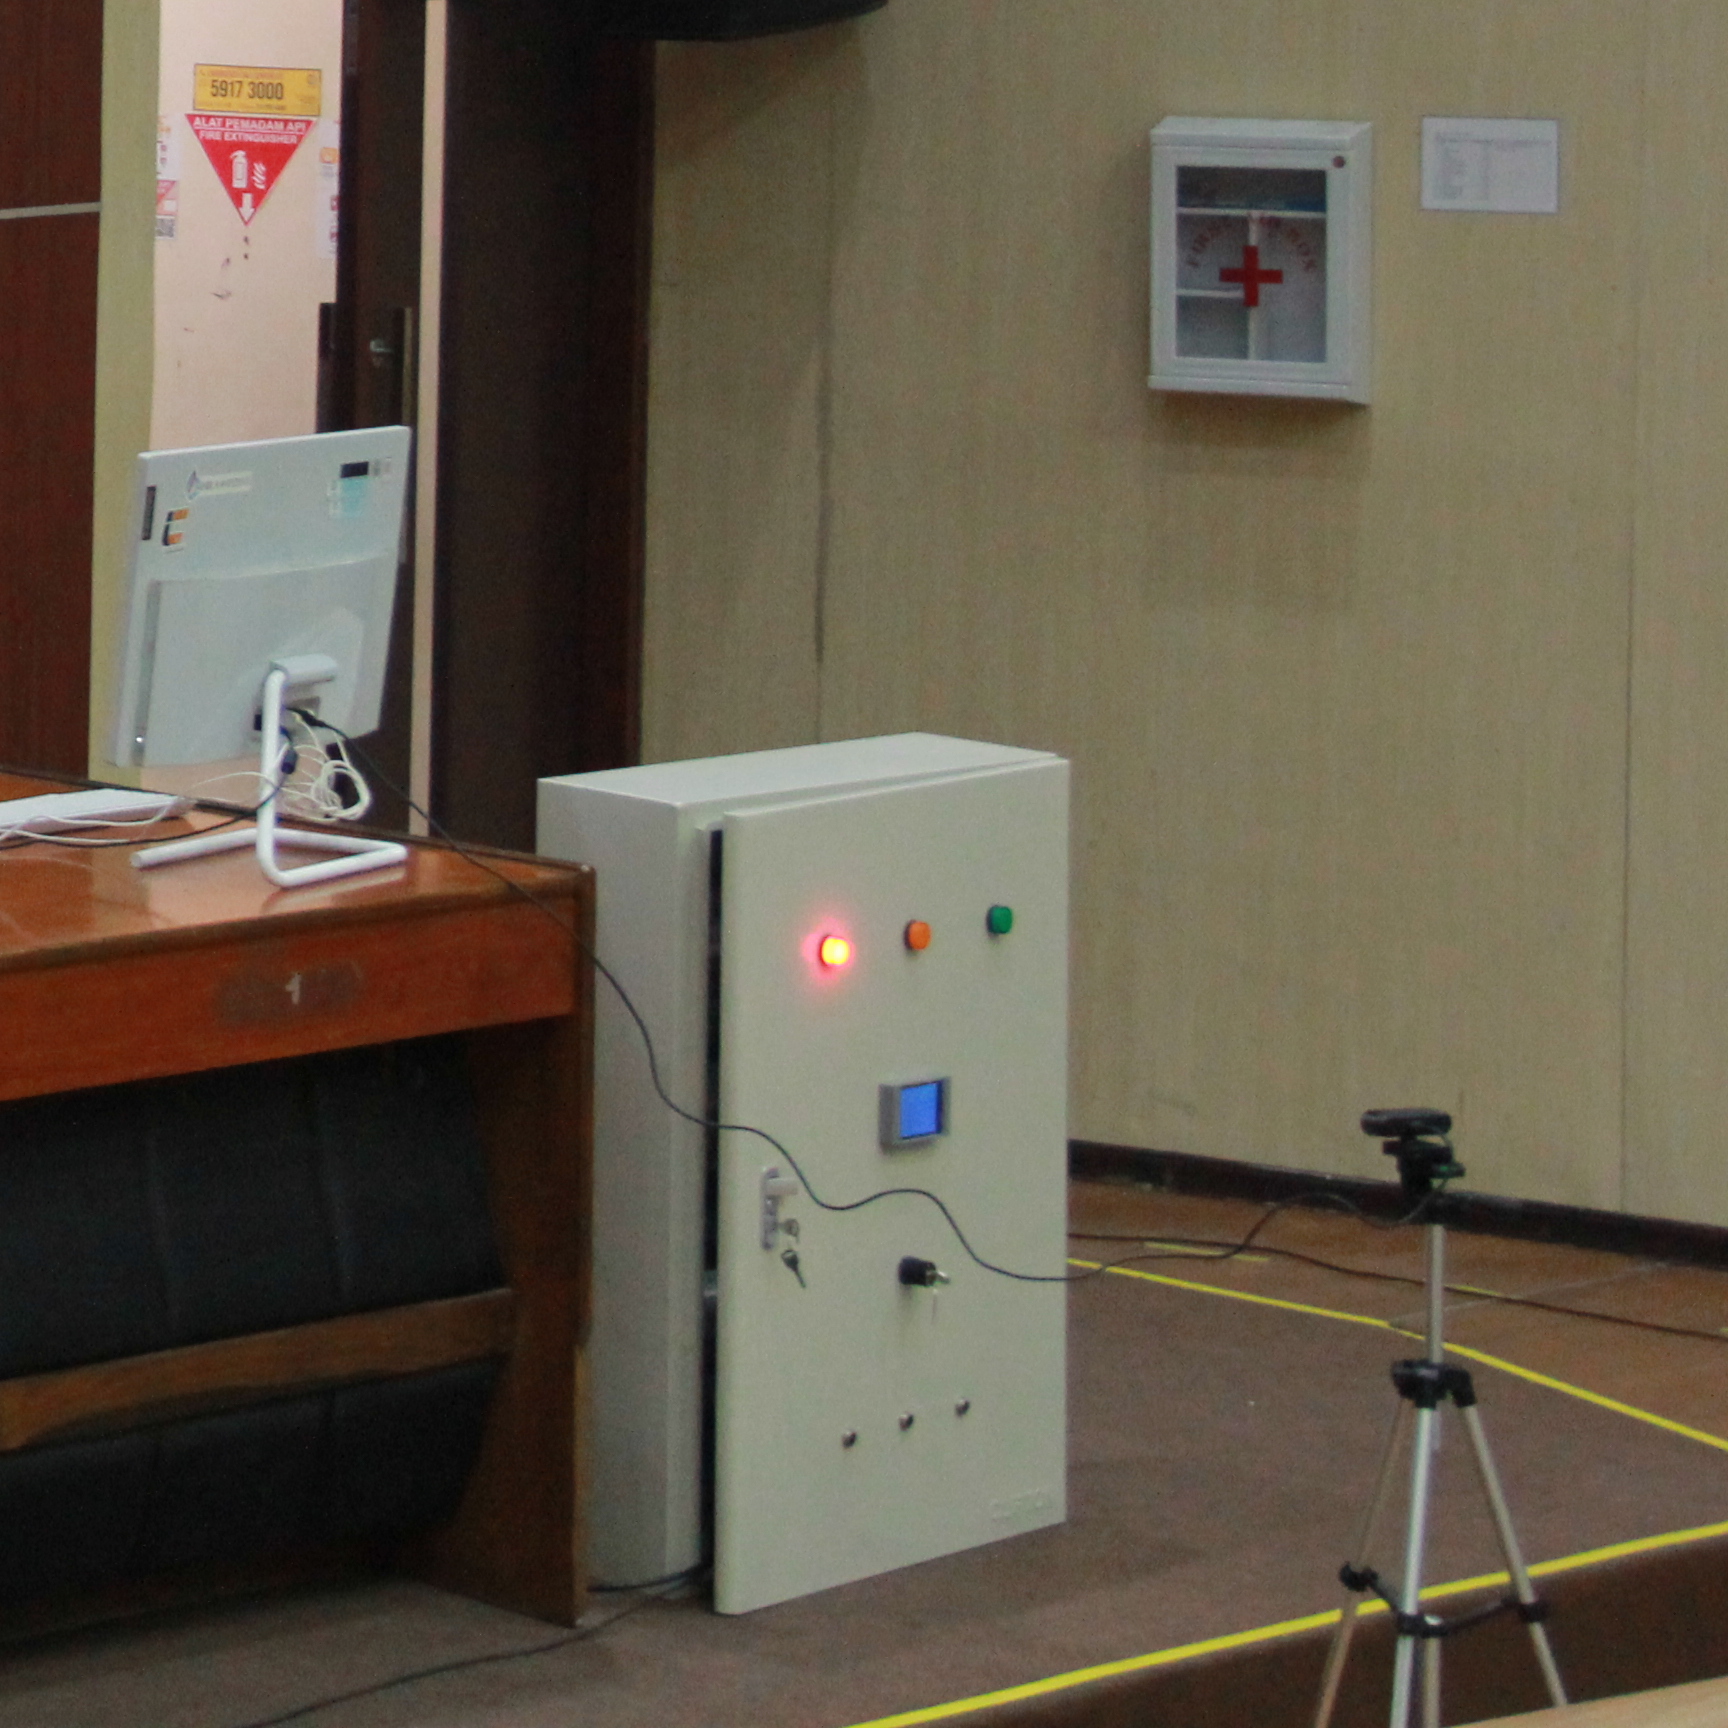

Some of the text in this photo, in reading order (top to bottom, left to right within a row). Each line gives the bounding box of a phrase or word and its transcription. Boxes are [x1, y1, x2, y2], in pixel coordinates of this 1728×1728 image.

[211, 79, 243, 98] 5917
[248, 81, 284, 100] 3000
[194, 117, 223, 129] ALAT
[226, 118, 284, 131] PEMADAM
[199, 131, 298, 144] FIRE EXTINGUISHER
